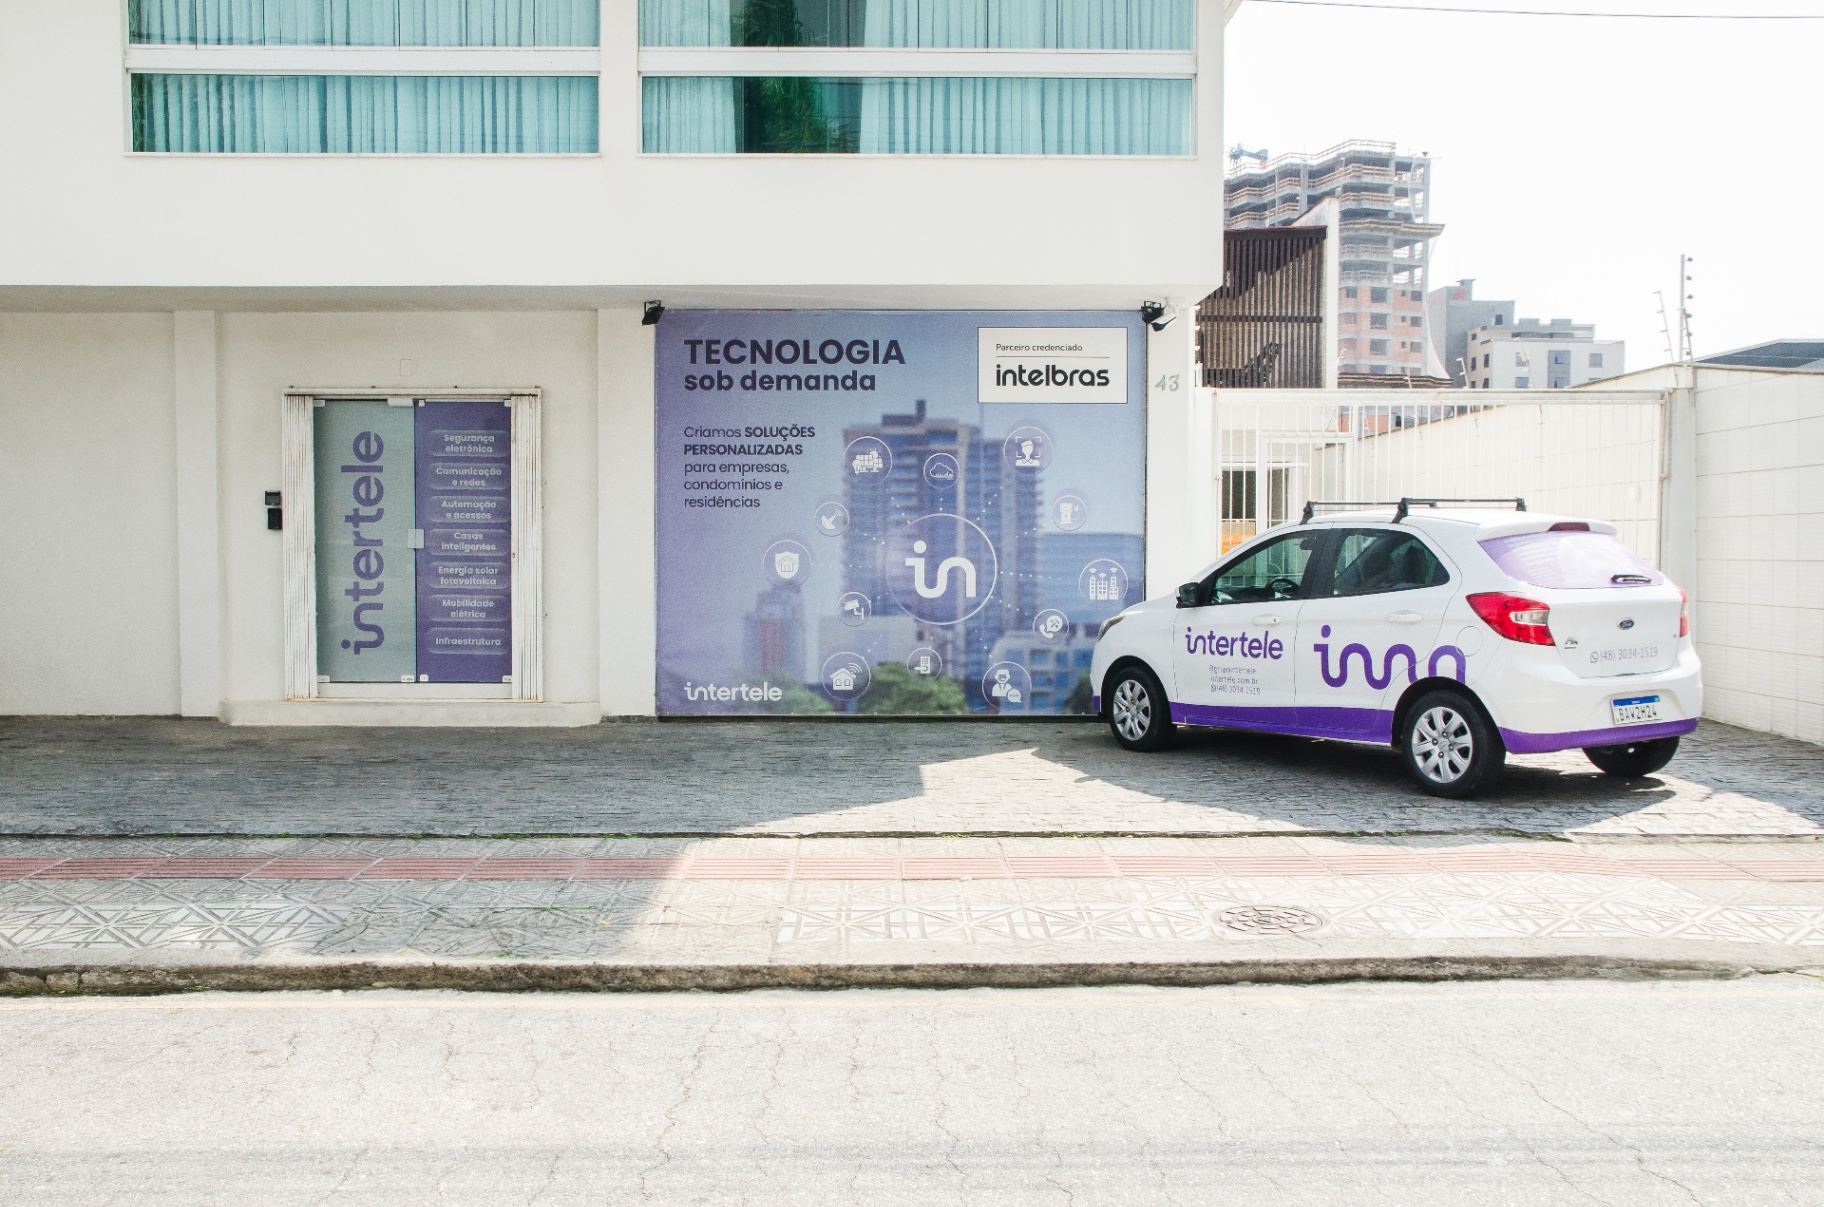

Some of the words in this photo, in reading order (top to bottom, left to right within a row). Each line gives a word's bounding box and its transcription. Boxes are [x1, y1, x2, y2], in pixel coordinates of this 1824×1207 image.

[684, 339, 906, 365] TECNOLOGIA
[996, 343, 1031, 352] Parceiro
[1032, 343, 1083, 352] credenciado
[684, 370, 734, 391] sob
[740, 370, 876, 391] demanda
[996, 364, 1110, 387] intelbras
[1155, 373, 1180, 392] 43
[683, 426, 742, 438] Criamos
[744, 423, 816, 442] SOLUÇÕES
[444, 434, 495, 445] Segurança
[445, 444, 493, 453] eletrônica
[684, 444, 803, 456] PERSONALIZADAS
[436, 467, 502, 477] Comunicação
[684, 463, 716, 476] para
[718, 463, 790, 477] empresas,
[683, 479, 772, 491] condomínios
[774, 481, 783, 490] e
[441, 500, 497, 511] Automação
[684, 496, 761, 508] residências
[454, 532, 483, 540] Casas
[341, 430, 385, 656] intertele
[441, 541, 497, 552] inteligentes
[438, 566, 474, 576] Energia
[475, 566, 499, 575] solar
[440, 576, 497, 585] fotovoltaica
[442, 599, 495, 607] Mobilidade
[450, 609, 486, 618] elétrica
[435, 637, 502, 646] Infraestrutura
[1185, 626, 1284, 660] intertele
[1600, 649, 1616, 662] (48)
[1618, 647, 1658, 660] 3034-1519
[683, 681, 783, 701] intertele
